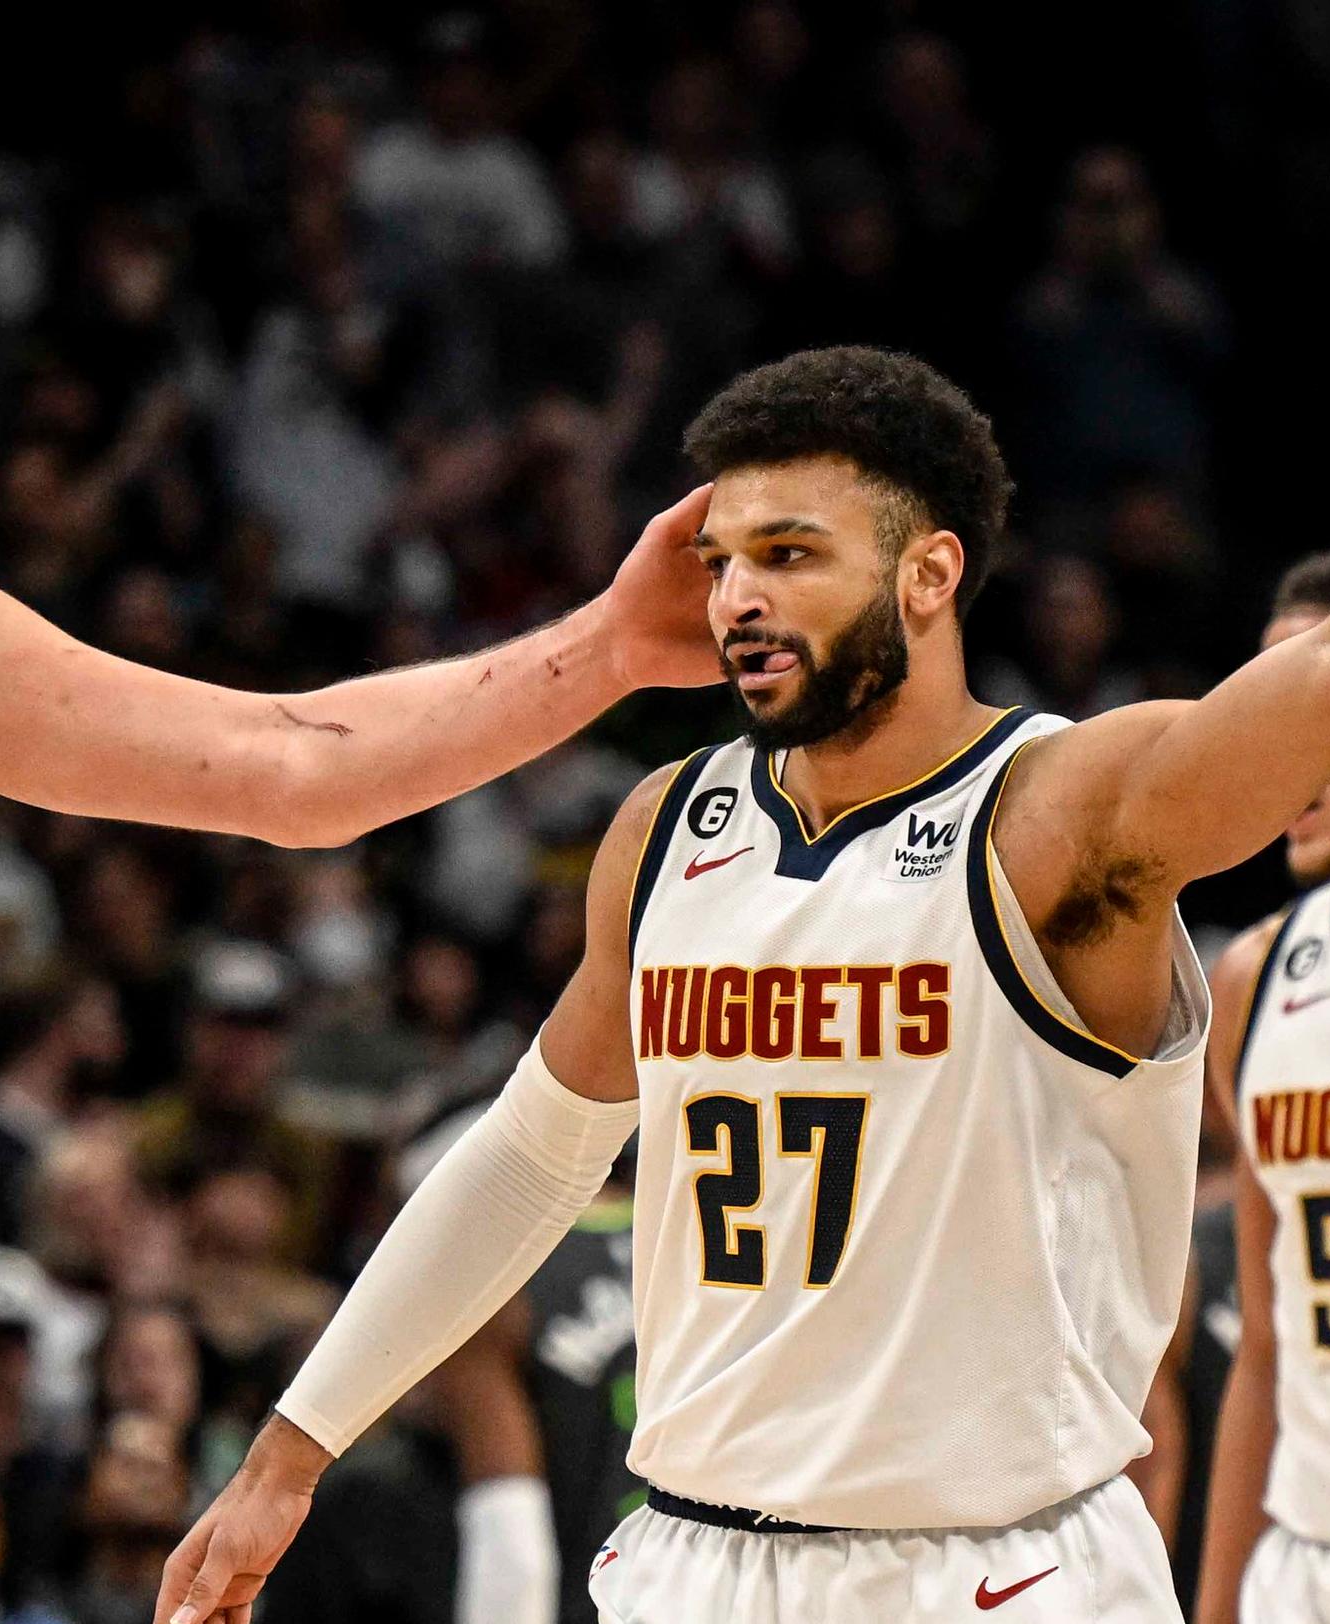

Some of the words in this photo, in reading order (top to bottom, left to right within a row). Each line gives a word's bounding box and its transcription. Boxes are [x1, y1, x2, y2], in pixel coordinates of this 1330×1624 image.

[698, 794, 734, 832] 6
[907, 812, 962, 850] WU
[894, 848, 954, 865] Western
[900, 865, 942, 878] Union
[639, 961, 951, 1062] NUGGETS
[682, 1089, 872, 1290] 27
